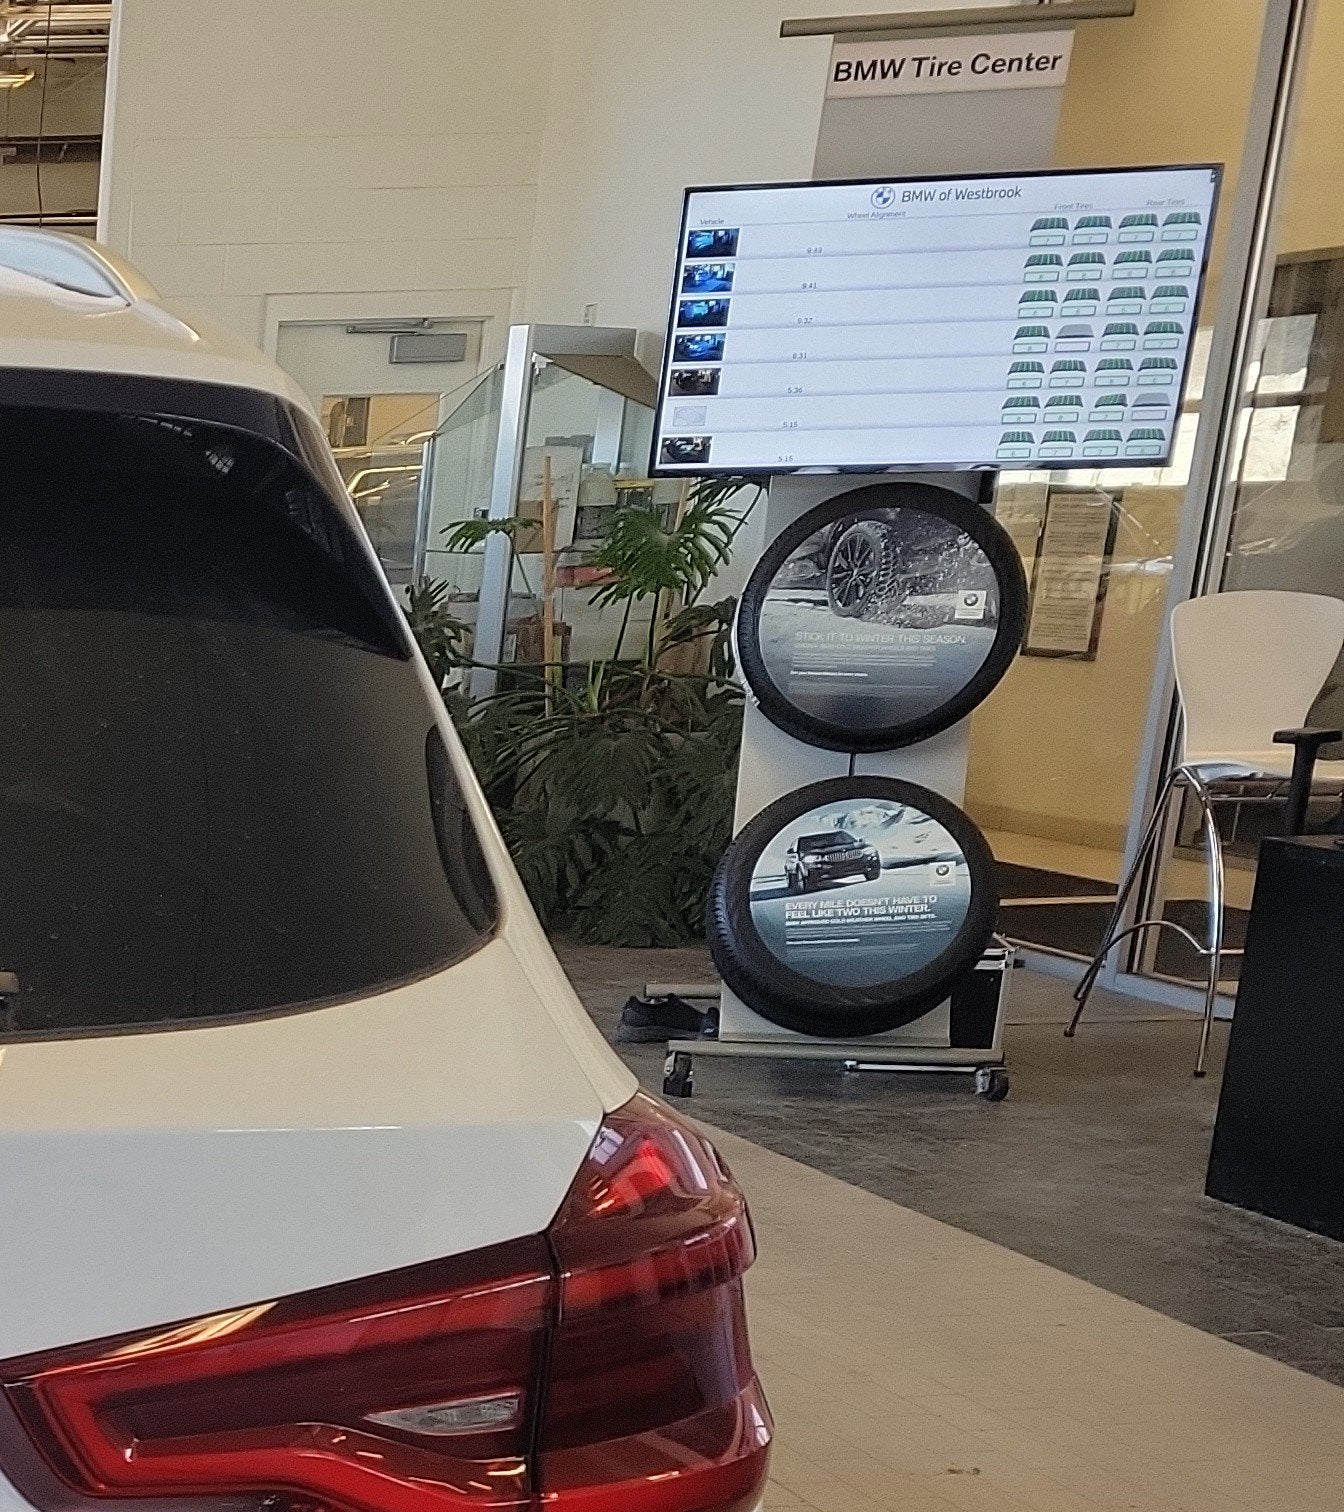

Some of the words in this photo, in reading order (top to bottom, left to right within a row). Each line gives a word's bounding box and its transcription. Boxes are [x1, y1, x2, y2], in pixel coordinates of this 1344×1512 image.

[833, 57, 906, 83] BMW
[911, 55, 963, 79] Tire
[970, 51, 1064, 75] Center
[901, 188, 938, 203] BMW
[939, 187, 953, 202] of
[955, 185, 1023, 201] Westbrook
[840, 632, 854, 643] TO
[856, 633, 895, 644] WINTER
[785, 901, 818, 911] EVERY
[820, 900, 845, 909] MILE
[893, 896, 922, 905] HAVE
[923, 895, 937, 904] TO
[785, 909, 811, 919] FEEL
[812, 908, 835, 918] LIKE
[837, 906, 861, 917] TWO
[863, 906, 886, 916] THIS
